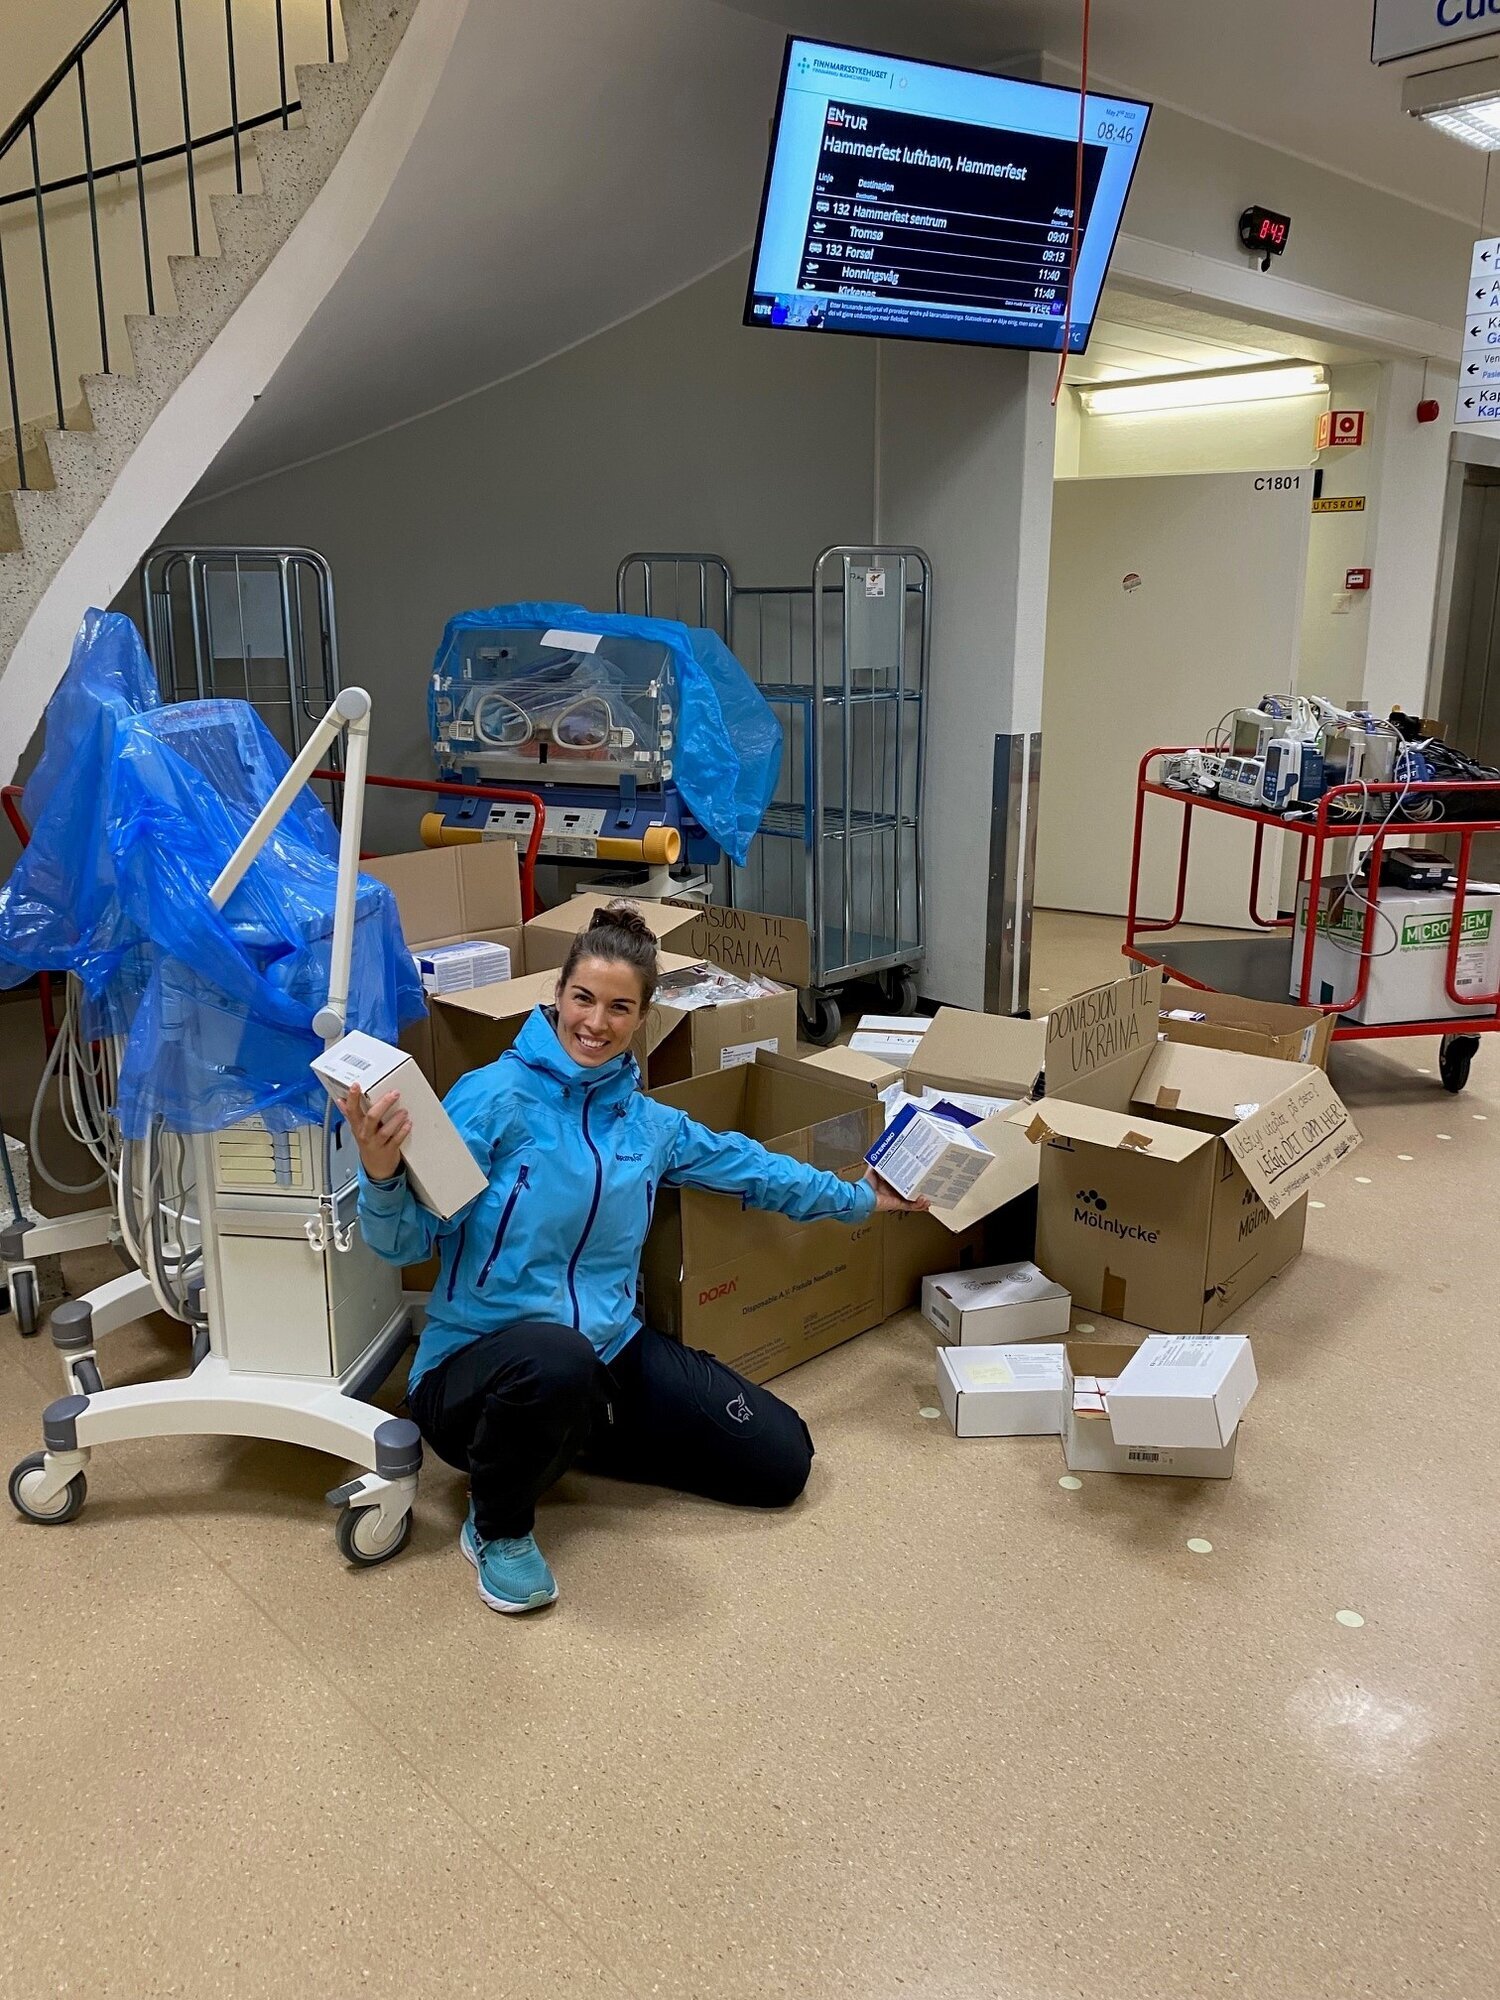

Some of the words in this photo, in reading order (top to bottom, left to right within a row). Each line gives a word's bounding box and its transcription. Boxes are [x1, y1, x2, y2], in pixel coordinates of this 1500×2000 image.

[812, 59, 887, 79] FINNMARKSSYKEHUSET
[1097, 121, 1134, 143] 08:46
[823, 136, 902, 162] Hammerfest
[902, 147, 953, 172] lufthavn,
[955, 156, 1027, 181] Hammerfest
[858, 179, 894, 192] Destinasjon
[832, 202, 850, 215] 132
[853, 205, 909, 223] Hammerfest
[910, 214, 947, 229] sentrum
[1047, 231, 1069, 244] 09:01
[850, 225, 884, 241] Tromsø
[1042, 250, 1065, 263] 09:13
[825, 243, 842, 256] 132
[845, 246, 875, 260] Forsøl
[1038, 269, 1061, 281] 11:40
[841, 266, 900, 286] Honningsvåg
[1034, 287, 1056, 299] 11:48
[1254, 476, 1300, 491] C1801
[1311, 500, 1363, 511] UKTSROM
[761, 917, 790, 943] TIL
[1406, 913, 1488, 943] MICROHEM
[691, 930, 783, 973] UKRAINA
[1049, 987, 1118, 1044] DONASJON
[1129, 976, 1153, 1010] TIL
[1072, 1013, 1140, 1072] UKRAINA
[875, 1131, 896, 1156] TERUMO
[1256, 1146, 1289, 1178] LEGG
[1280, 1130, 1304, 1161] DET
[1319, 1099, 1349, 1130] HER!
[1074, 1207, 1159, 1244] Mölnlycke
